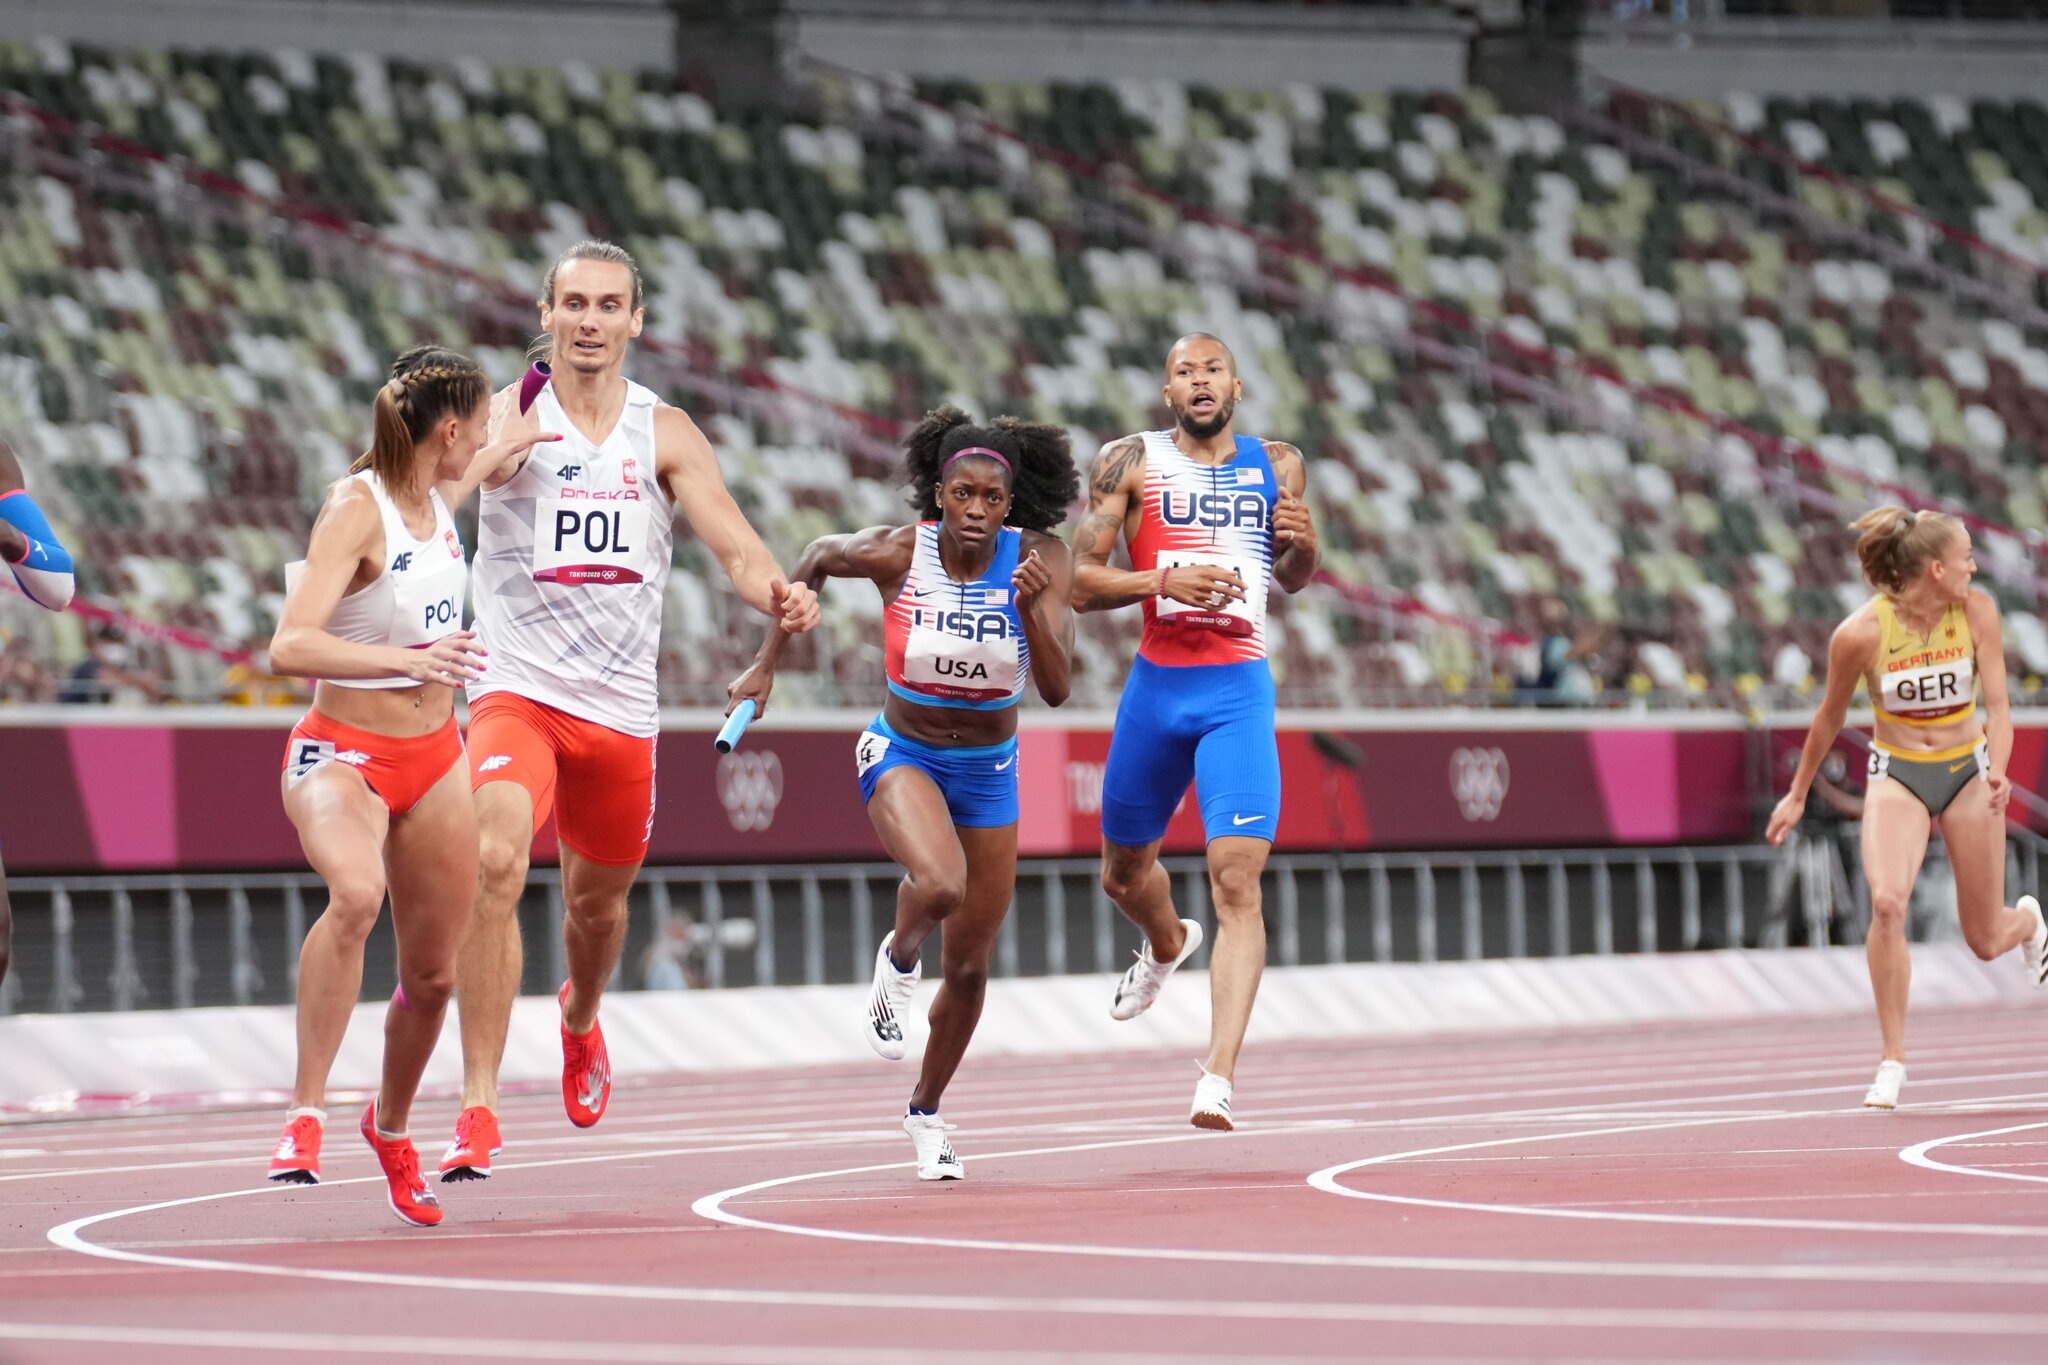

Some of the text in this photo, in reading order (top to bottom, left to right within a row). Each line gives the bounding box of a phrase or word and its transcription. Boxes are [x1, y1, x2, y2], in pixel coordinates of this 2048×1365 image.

[557, 464, 582, 481] 4F
[1163, 490, 1265, 528] USA
[555, 510, 629, 553] POL
[391, 551, 413, 572] 4F
[425, 595, 458, 629] POL
[915, 609, 1008, 642] USA
[935, 657, 988, 679] USA
[1887, 646, 1964, 672] GERMANY
[1897, 671, 1957, 702] GER
[861, 737, 875, 763] 4
[1868, 750, 1879, 775] 3
[478, 755, 512, 772] 4F
